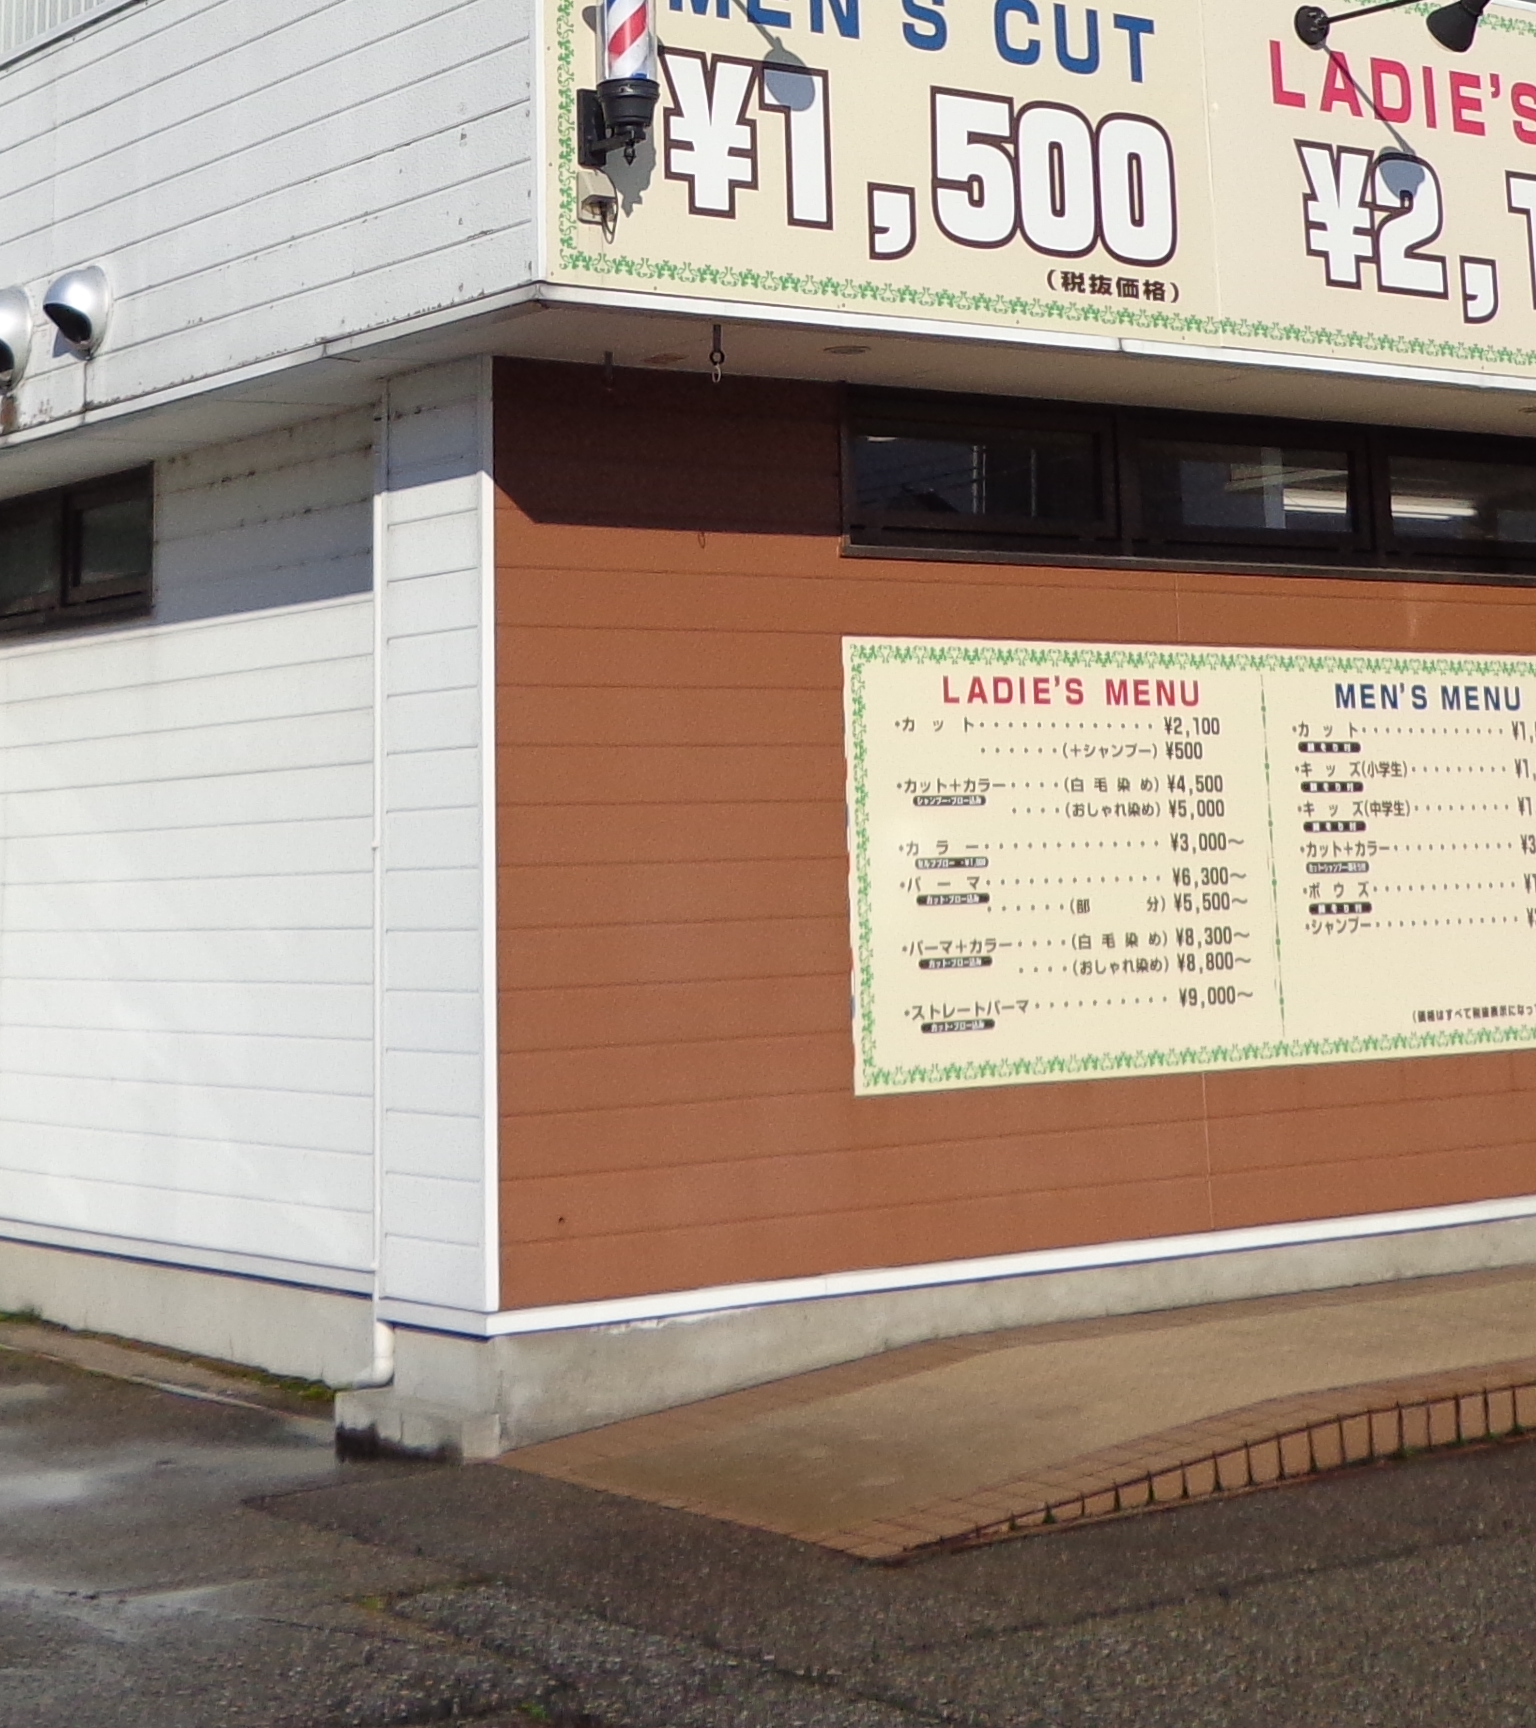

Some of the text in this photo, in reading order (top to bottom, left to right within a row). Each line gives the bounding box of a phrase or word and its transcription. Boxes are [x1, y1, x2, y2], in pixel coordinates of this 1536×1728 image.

[657, 44, 1178, 268] ¥1,500
[1046, 268, 1180, 304] (税抜価格)
[942, 674, 1201, 707] LADIE'S MENU
[1334, 681, 1522, 712] MEN'S MENU
[1163, 716, 1221, 738] ¥2,100
[1165, 741, 1203, 760] ¥500
[1166, 774, 1224, 796] ¥4,500
[1168, 799, 1226, 821] ¥5,000
